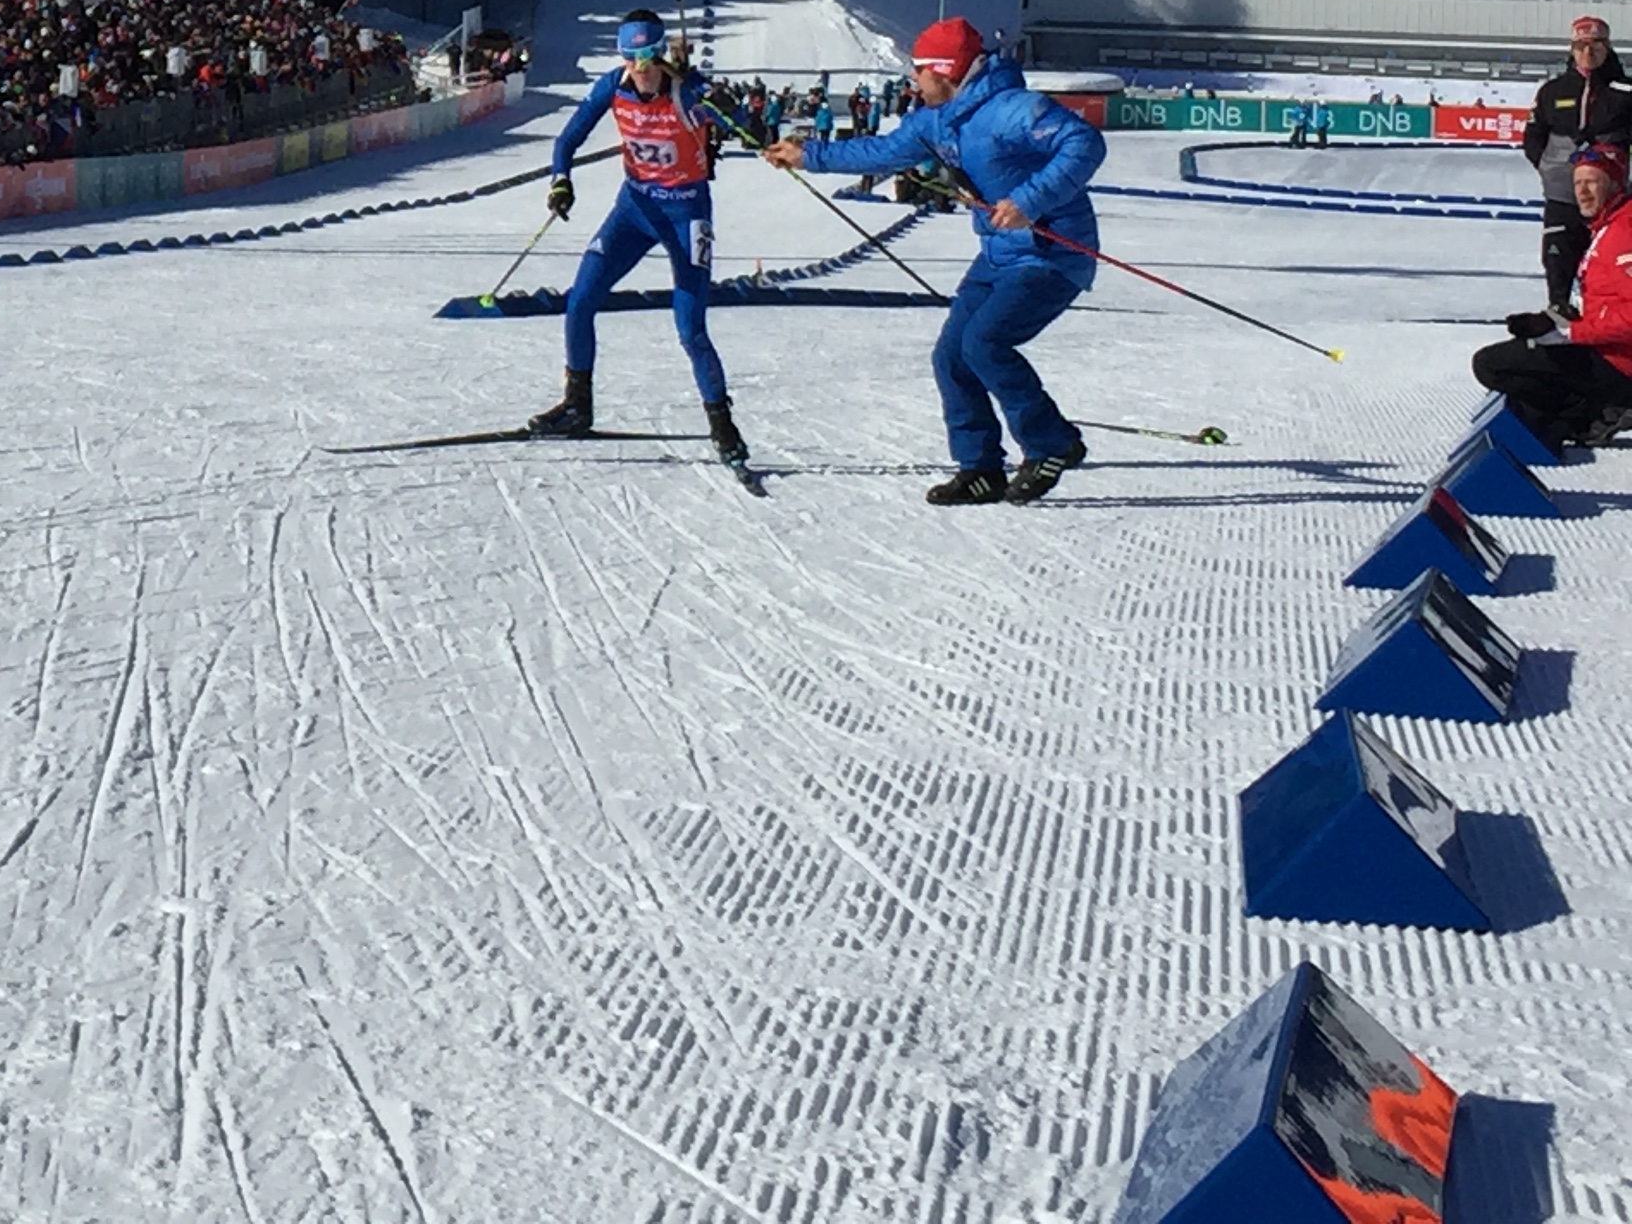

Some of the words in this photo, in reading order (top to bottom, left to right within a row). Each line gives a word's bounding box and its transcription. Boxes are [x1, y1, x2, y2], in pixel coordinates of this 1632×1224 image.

[1121, 99, 1167, 129] DNB
[1190, 100, 1242, 130] DNB
[1359, 106, 1411, 136] DNB
